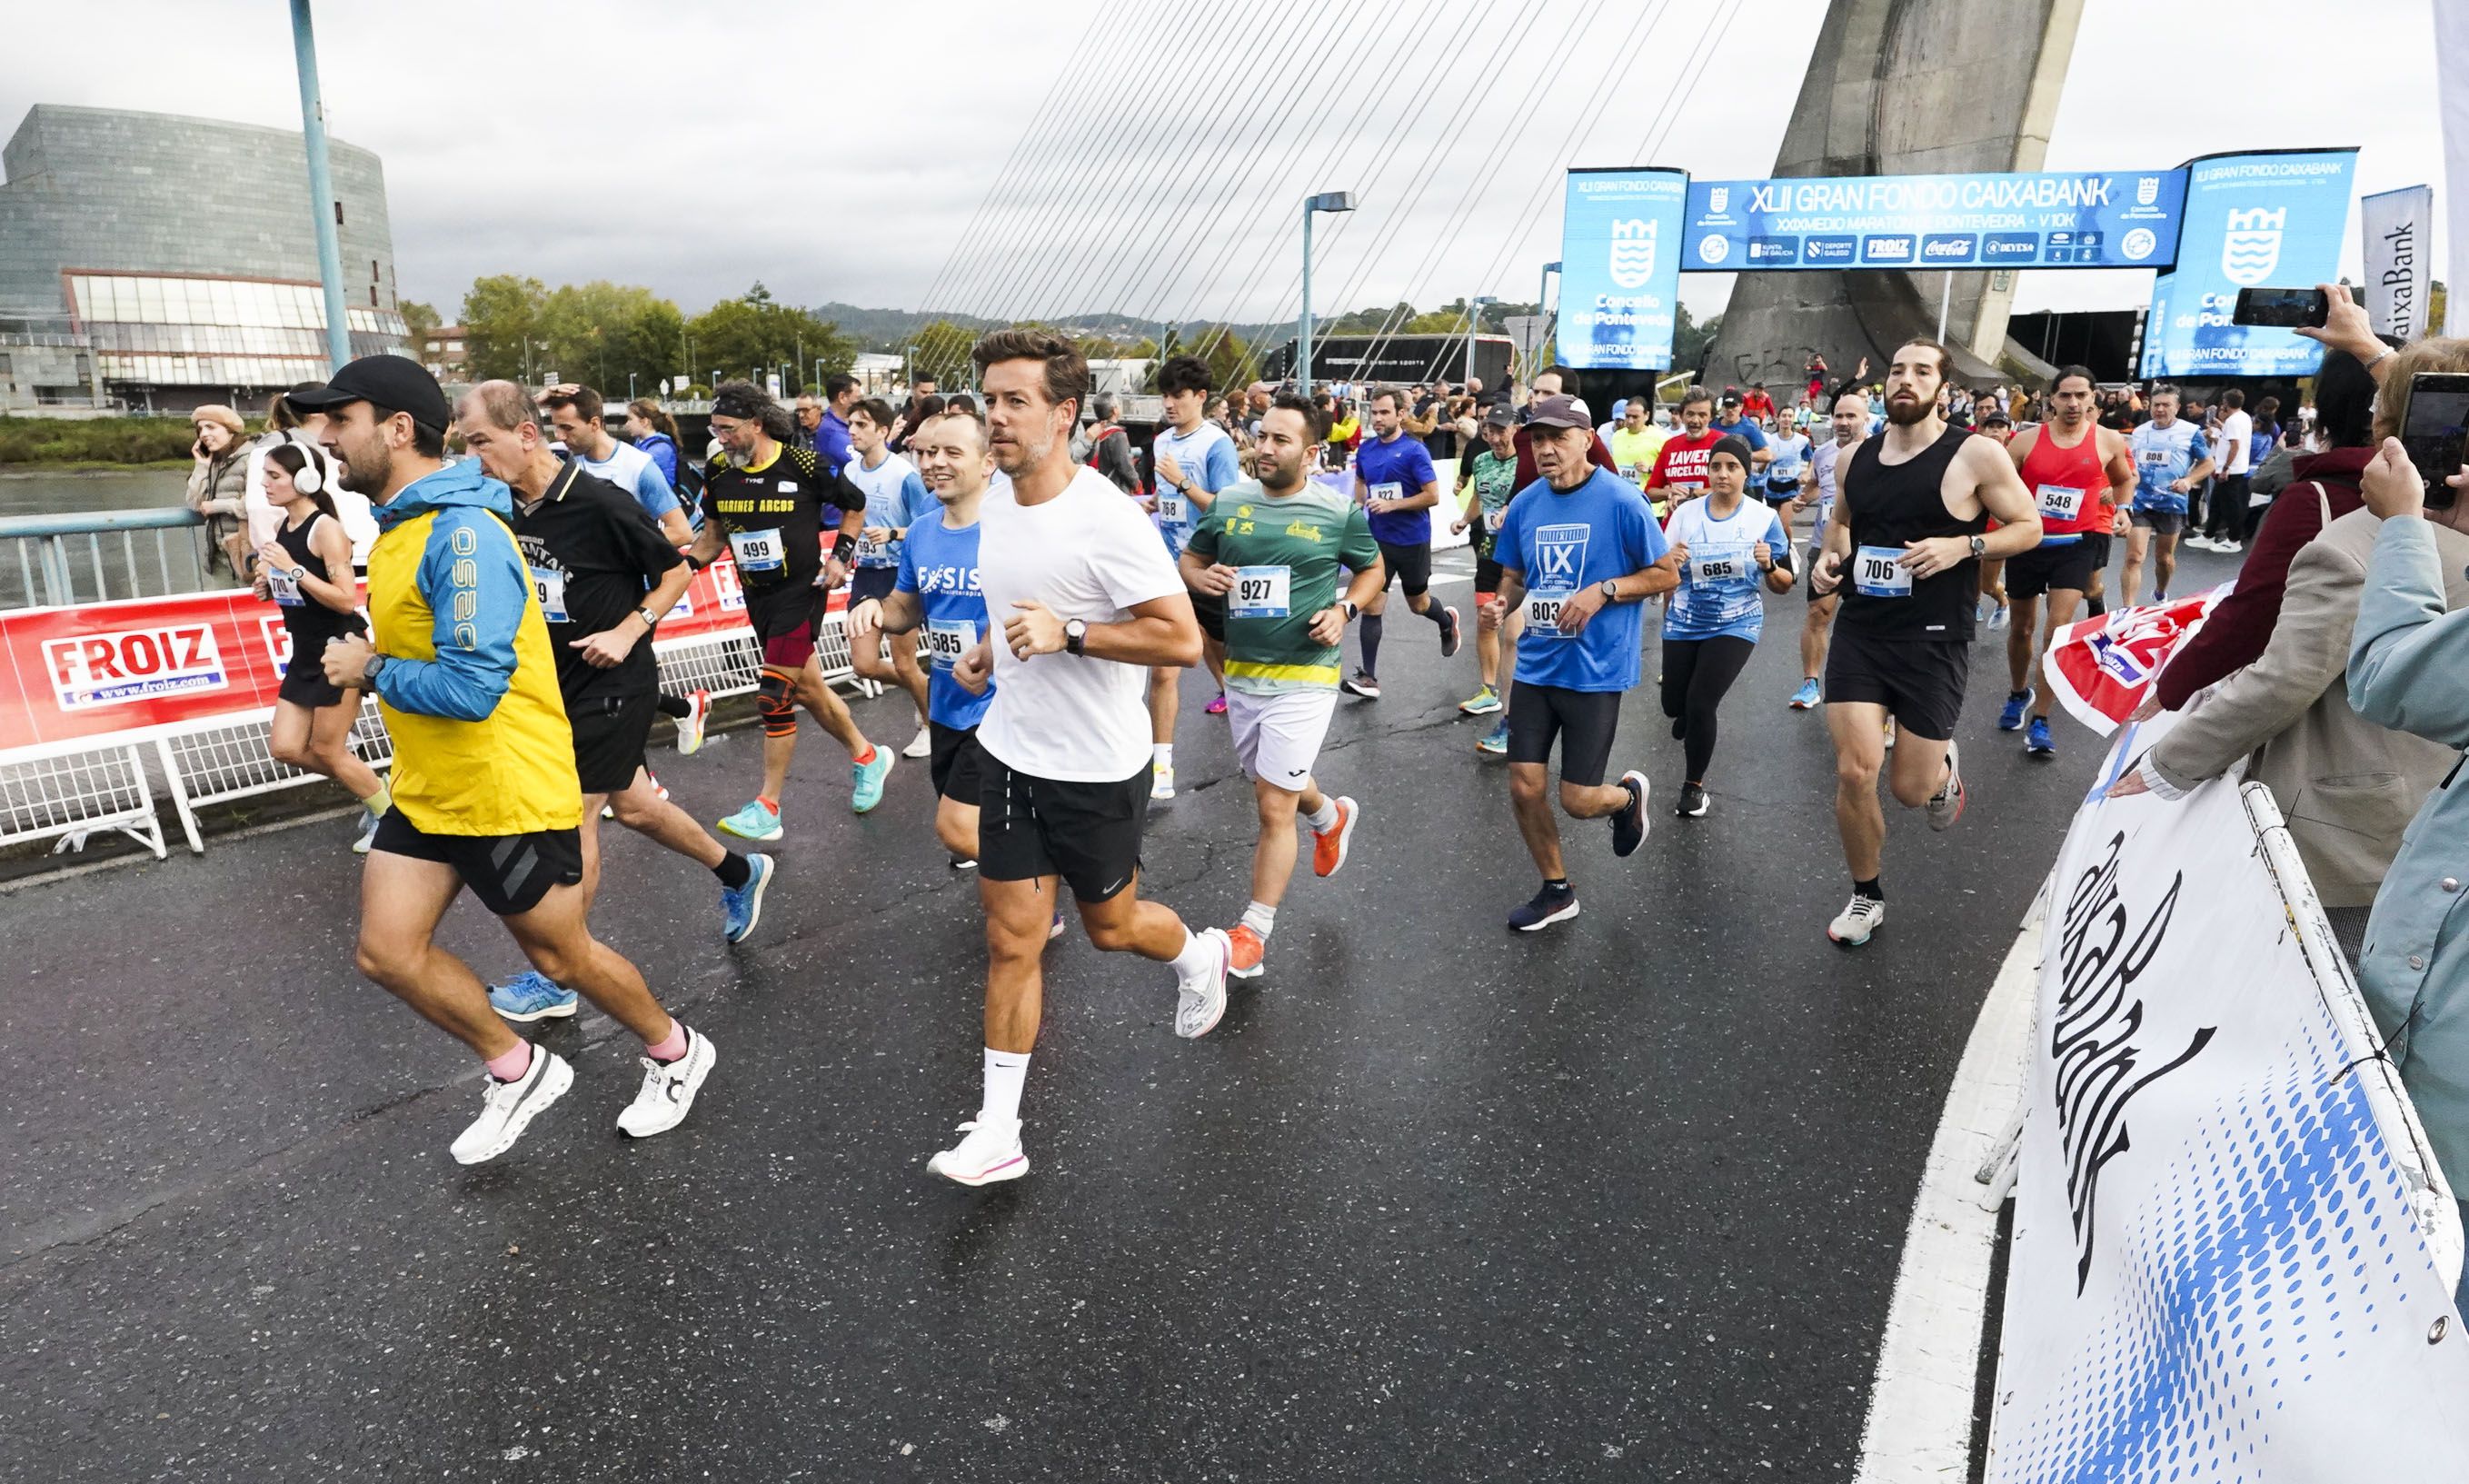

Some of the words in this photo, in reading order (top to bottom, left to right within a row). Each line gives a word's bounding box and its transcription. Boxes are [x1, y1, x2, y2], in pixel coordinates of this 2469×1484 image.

[2209, 166, 2239, 180] GRAN
[2239, 164, 2279, 178] FONDO
[2280, 162, 2344, 176] CAIXABANK
[1618, 180, 1649, 193] FONDO
[1749, 185, 1792, 214] XLII
[1796, 183, 1864, 212] GRAN
[1867, 181, 1956, 211] FONDO
[1962, 177, 2113, 208] CAIXABANK
[1938, 213, 2026, 229] PONTEVEDRA
[1867, 238, 1910, 254] FROIZ
[1596, 294, 1660, 308] Concello
[1572, 312, 1593, 325] de
[2176, 314, 2196, 327] de
[1607, 344, 1636, 355] FONDO
[2211, 347, 2247, 361] FONDO
[759, 499, 795, 513] ARCOS
[2045, 493, 2072, 509] 548
[742, 541, 770, 558] 499
[1543, 544, 1576, 574] IX
[1702, 561, 1733, 577] 685
[1865, 559, 1895, 581] 706
[1240, 580, 1272, 601] 927
[1531, 602, 1561, 622] 803
[931, 632, 962, 654] 585
[51, 628, 214, 685] FROIZ
[99, 675, 210, 700] www.froiz.com
